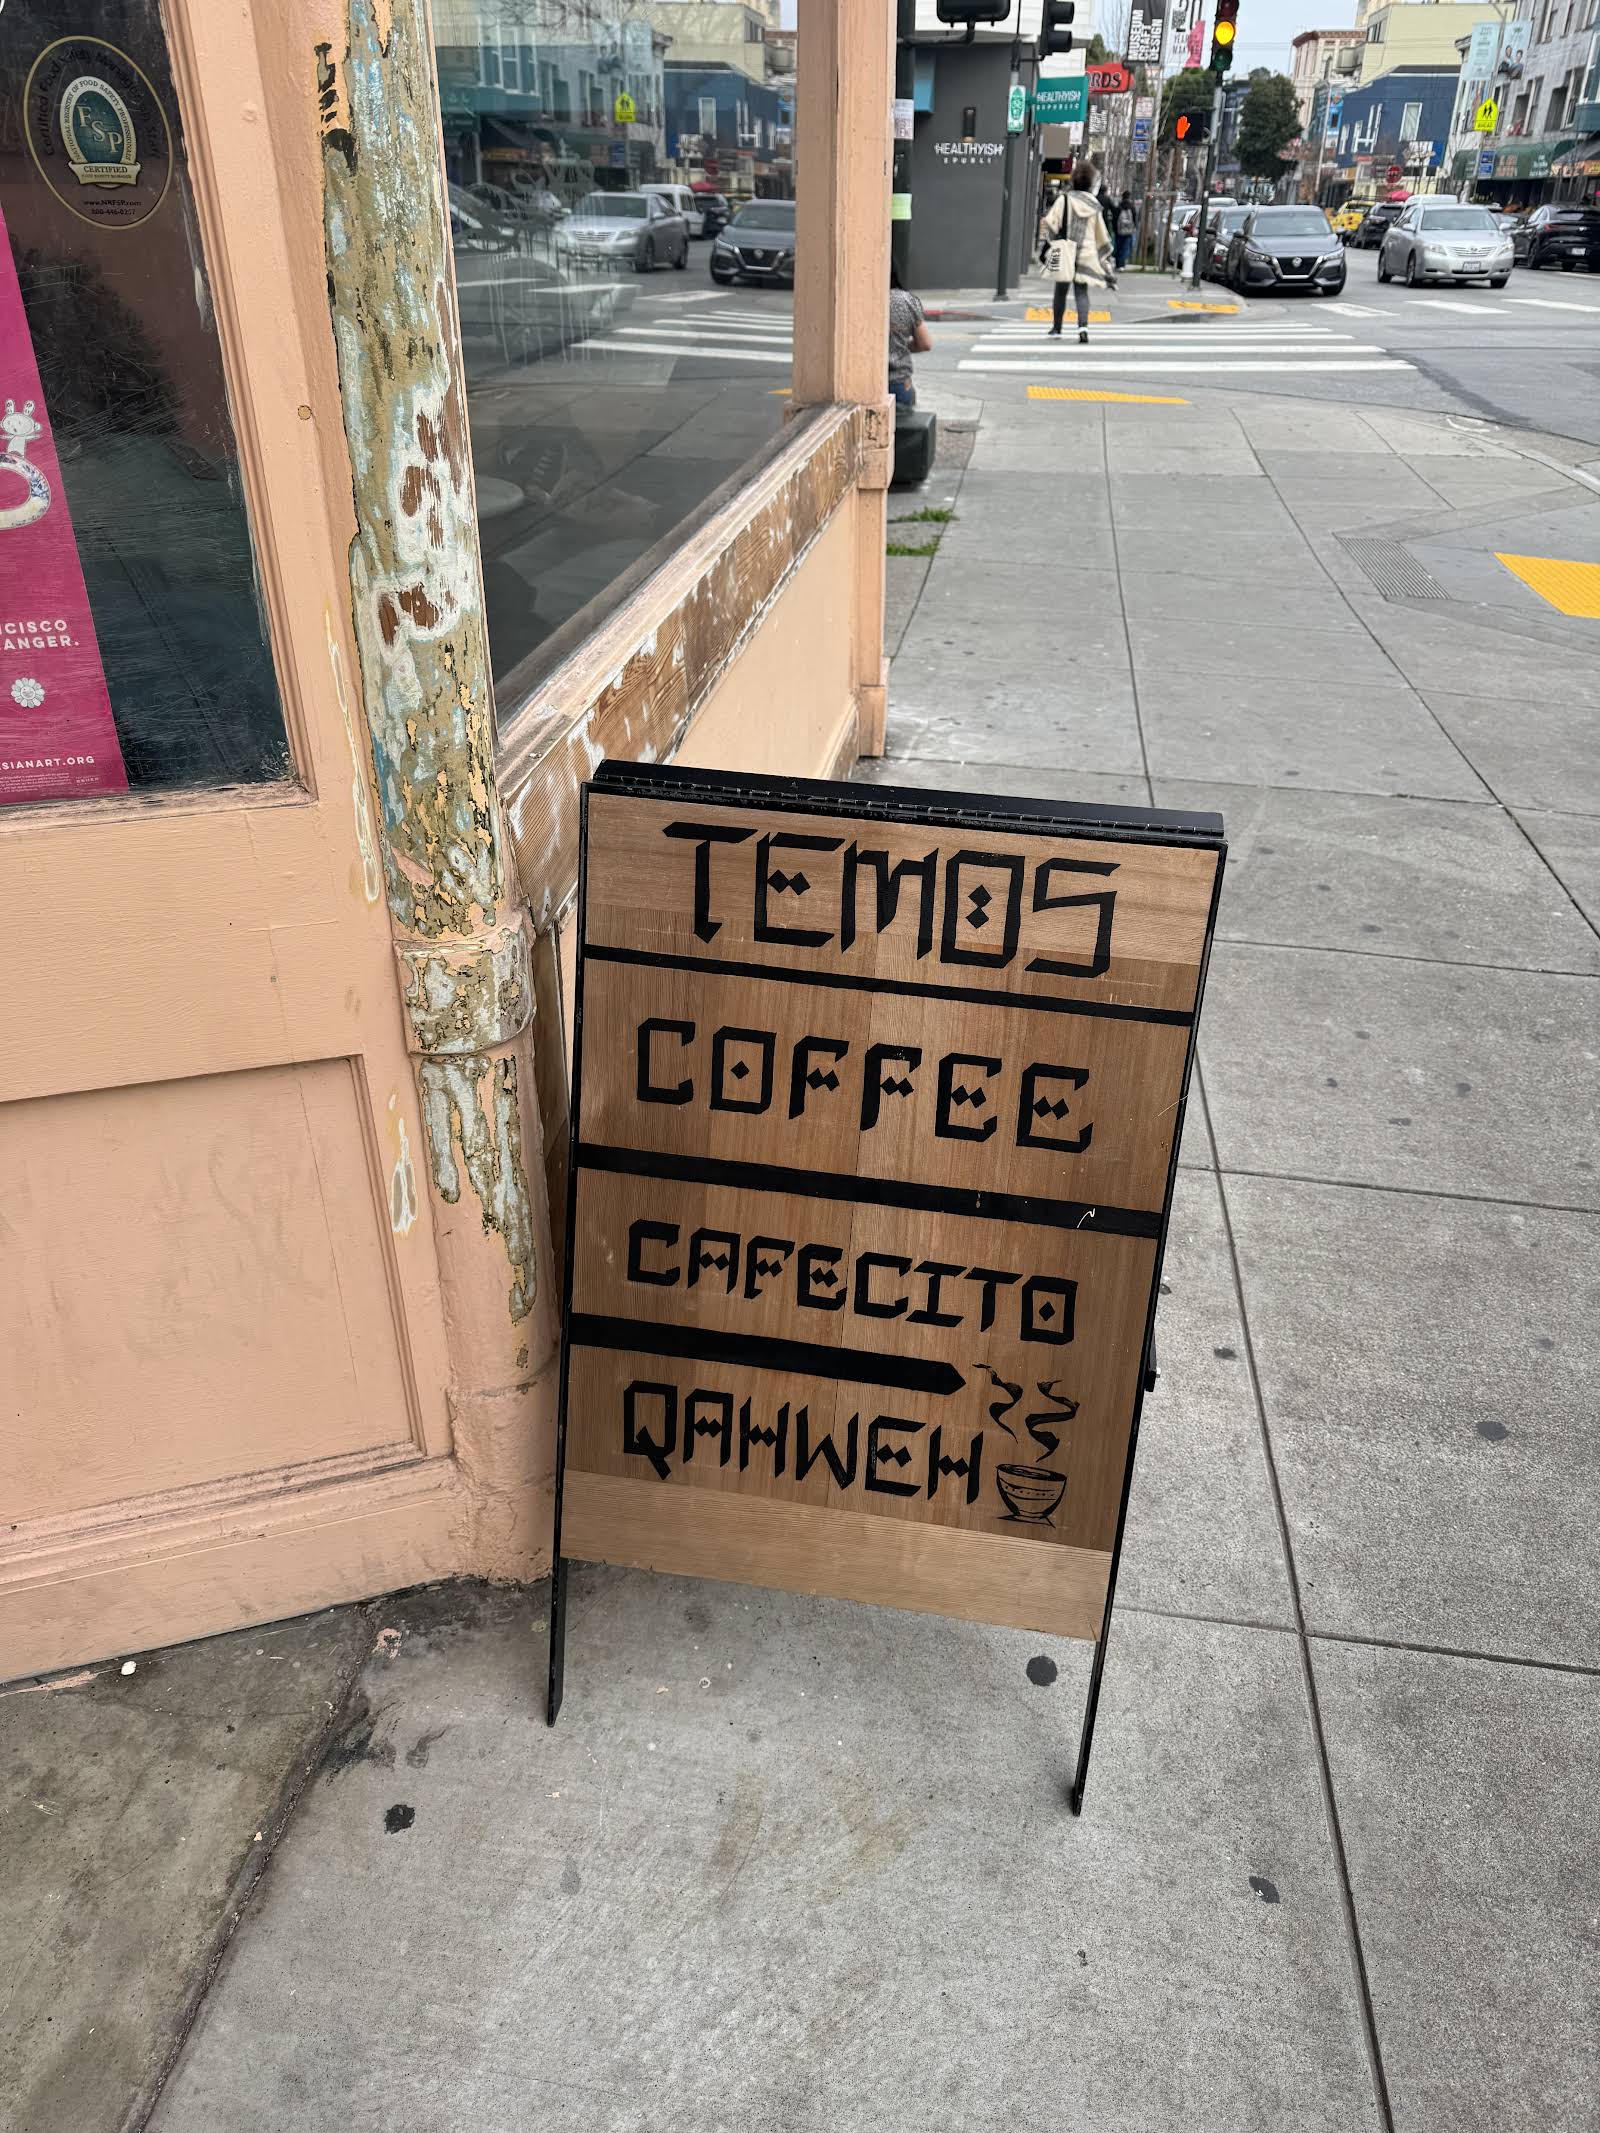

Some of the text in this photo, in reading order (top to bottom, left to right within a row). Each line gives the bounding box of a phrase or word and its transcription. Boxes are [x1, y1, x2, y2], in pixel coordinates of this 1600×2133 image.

[1128, 9, 1144, 60] MUSEUM
[1137, 24, 1152, 61] CRAFT
[1148, 18, 1163, 61] DESIGN
[71, 83, 80, 93] OF
[79, 79, 99, 88] FOOD
[99, 83, 121, 107] SAFETY
[1086, 71, 1122, 88] RDS
[1036, 89, 1082, 103] HEALTHYISH
[934, 142, 1004, 156] HEALTHYISH
[83, 165, 128, 173] CERTIFIED
[2, 635, 80, 651] ANGER.
[0, 755, 95, 771] SIANART.ORG
[662, 821, 1121, 978] TEMOS
[637, 1016, 1093, 1154] COFFEE
[627, 1218, 1079, 1345] CAFECITO
[622, 1380, 985, 1505] QAHWEH
